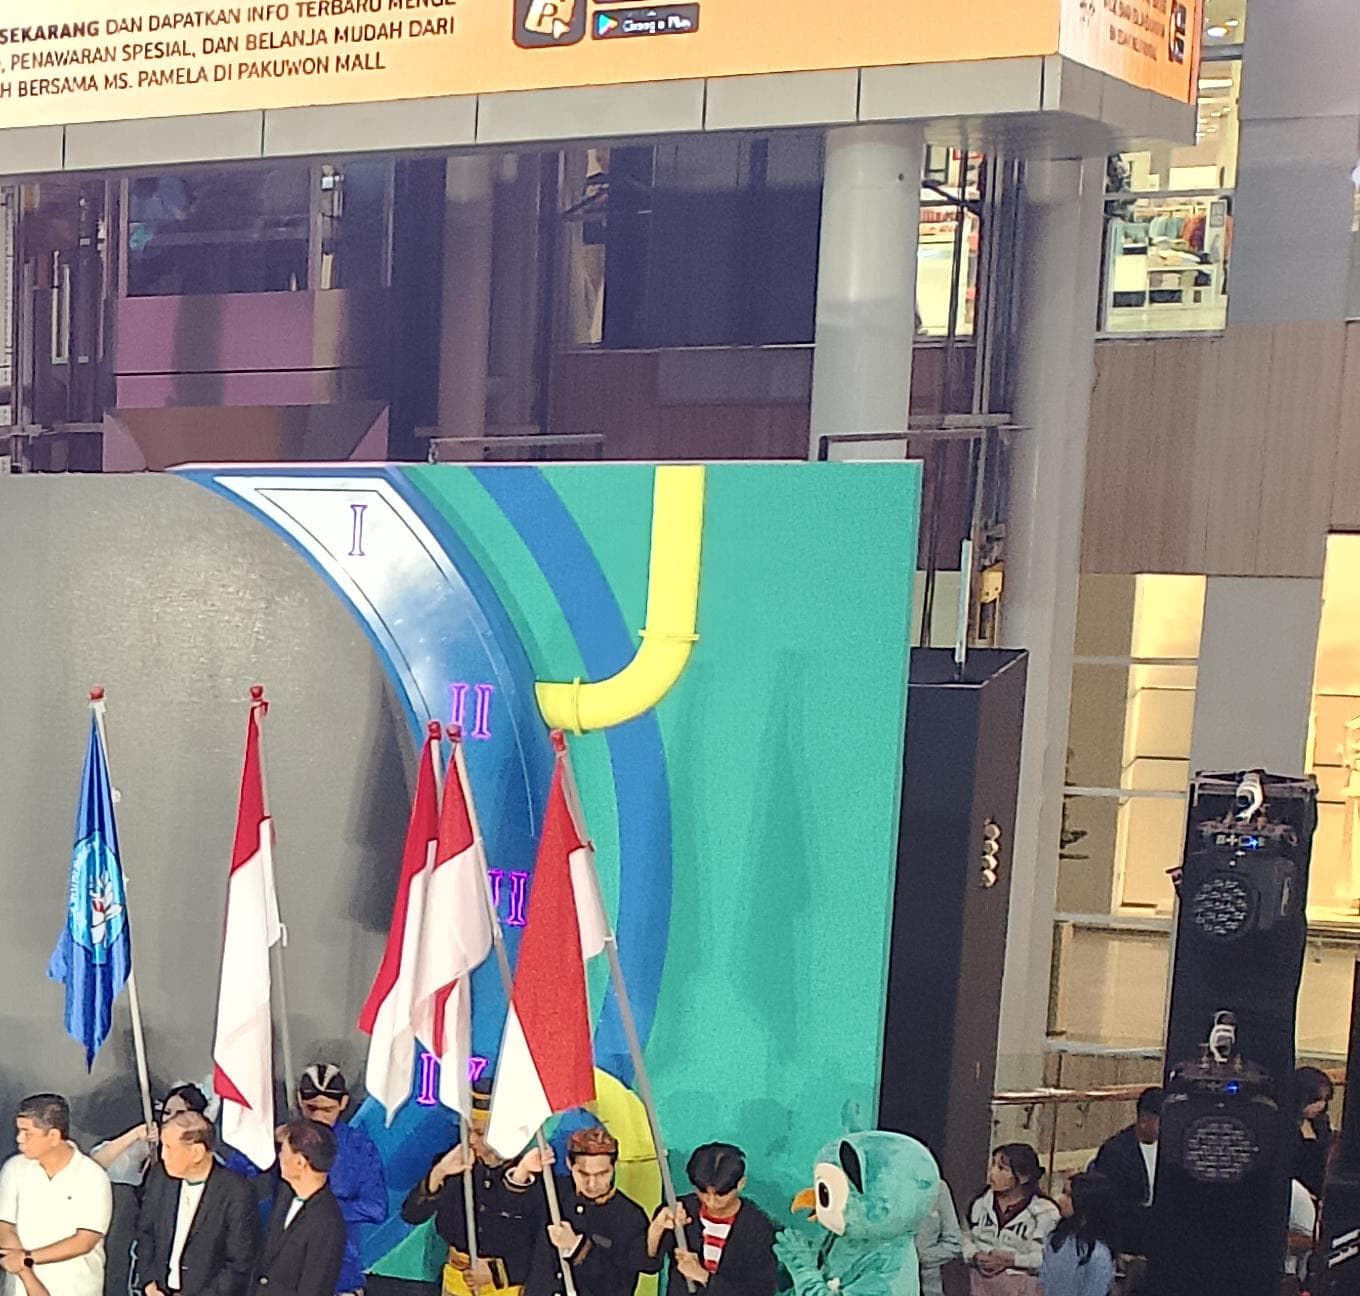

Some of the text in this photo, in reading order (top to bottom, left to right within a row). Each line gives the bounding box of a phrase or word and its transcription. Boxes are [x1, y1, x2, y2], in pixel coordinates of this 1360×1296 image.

[106, 17, 143, 36] DAN
[148, 9, 241, 33] DAPATKAN
[247, 3, 289, 22] INFO
[11, 47, 116, 72] PENAWARAN
[123, 39, 196, 62] SPESIAL,
[202, 36, 239, 55] DAN
[245, 29, 328, 52] BELANJA
[334, 24, 402, 44] MUDAH
[409, 19, 454, 37] DARI
[18, 76, 98, 97] BERSAMA
[104, 71, 134, 91] MS.
[138, 65, 209, 88] PAMELA
[215, 63, 233, 81] DI
[238, 55, 330, 80] PAKUWON
[336, 52, 385, 73] MALL
